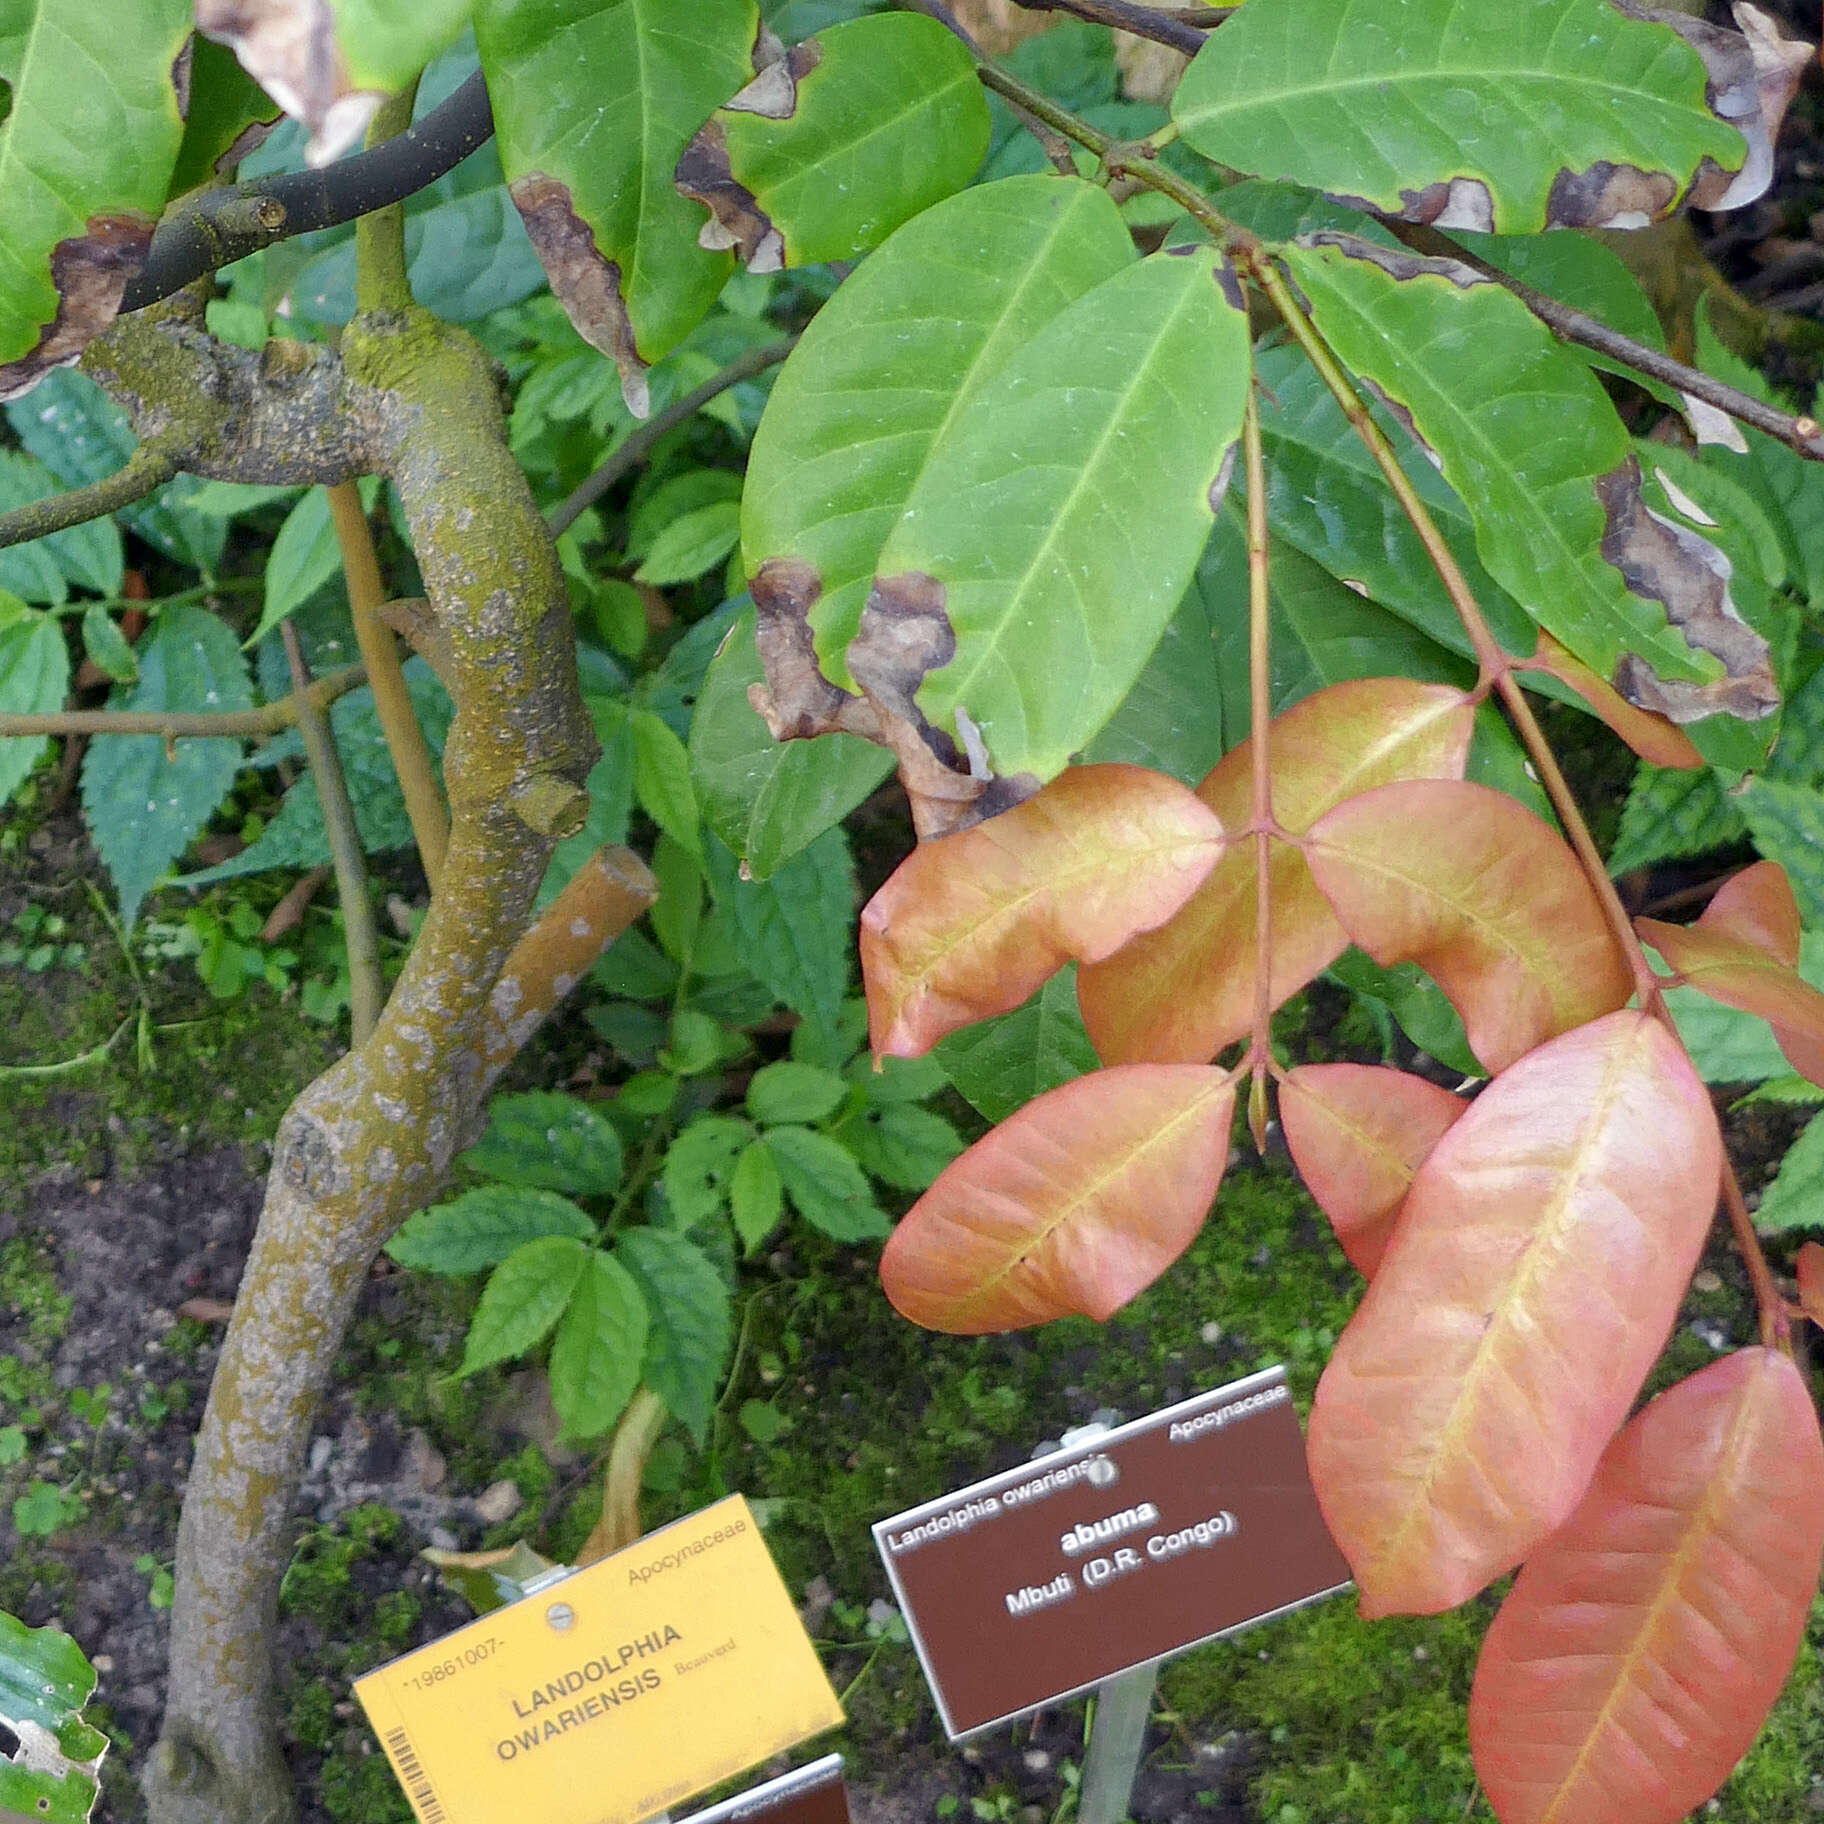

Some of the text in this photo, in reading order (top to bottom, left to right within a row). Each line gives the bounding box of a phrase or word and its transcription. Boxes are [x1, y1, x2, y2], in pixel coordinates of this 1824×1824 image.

[1170, 1384, 1288, 1440] Apocynaceae
[628, 1519, 747, 1586] Apocynaceae
[887, 1497, 999, 1551] Landolphia
[1060, 1502, 1157, 1552] abuma
[1005, 1510, 1234, 1614] Mbuti (D.R. Congo)
[512, 1625, 682, 1719] LANDOLPHIA
[497, 1668, 662, 1761] OWARIENSIS
